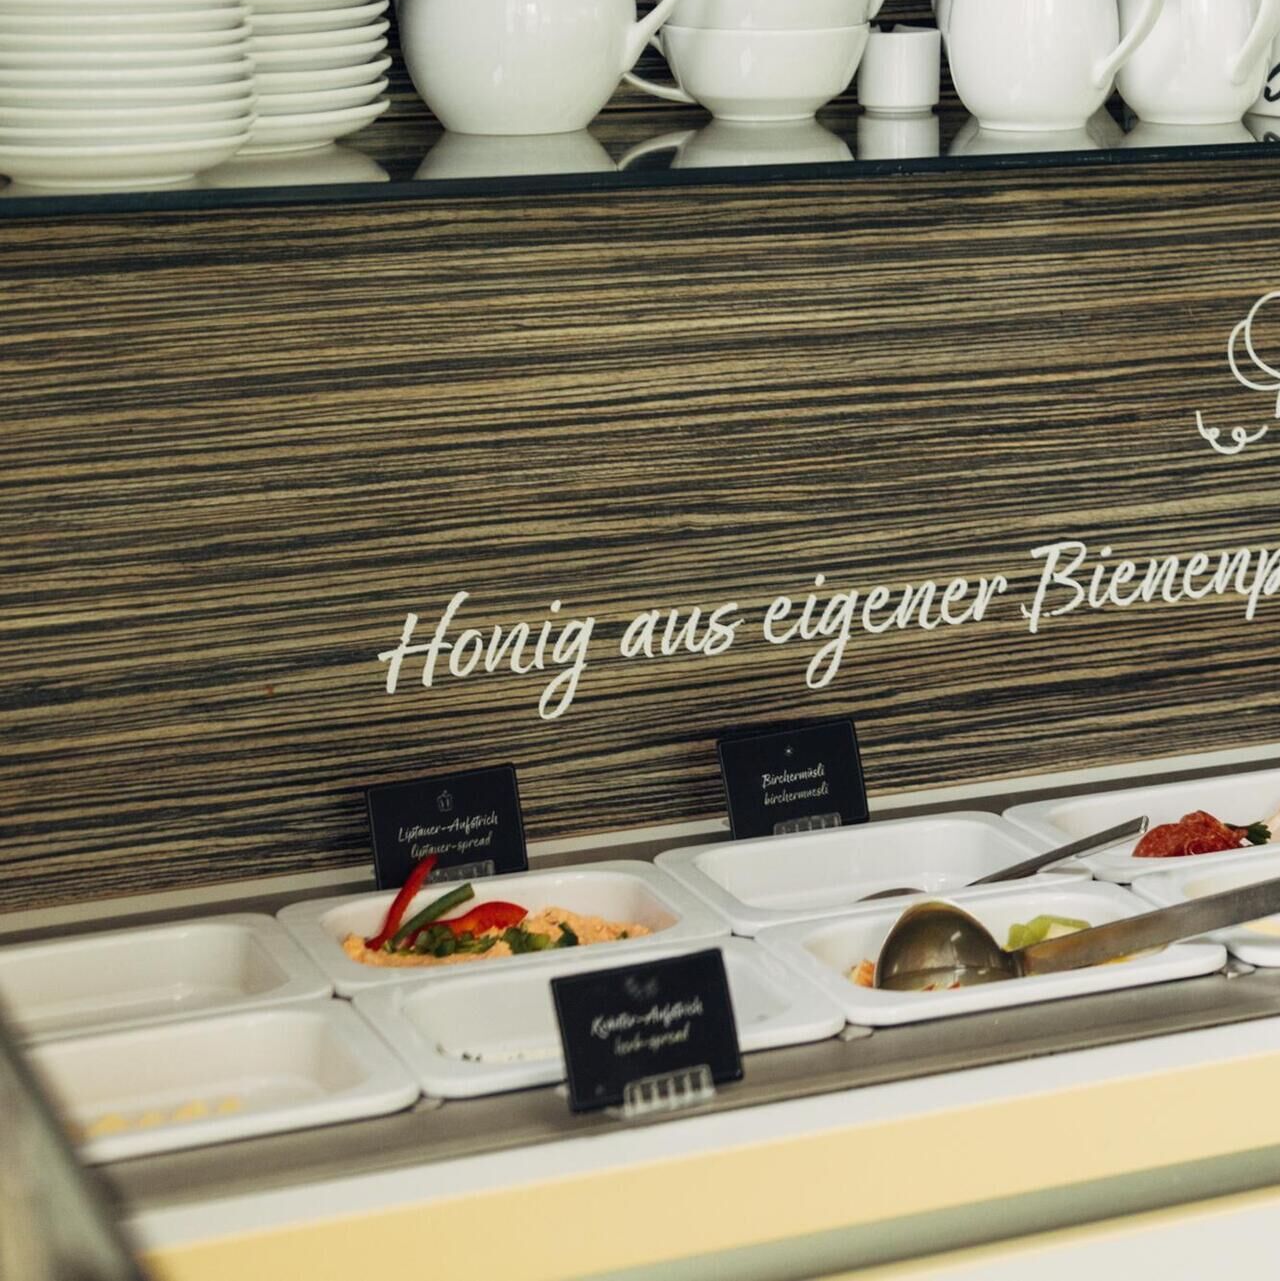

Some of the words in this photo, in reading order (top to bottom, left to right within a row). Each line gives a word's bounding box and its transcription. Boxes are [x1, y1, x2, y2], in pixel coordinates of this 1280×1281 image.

[377, 590, 597, 721] Honig
[619, 605, 745, 660] aus
[761, 571, 1010, 691] eigener
[761, 761, 826, 789] Birchermüsli
[397, 809, 499, 843] Liptauer-Aufstrich
